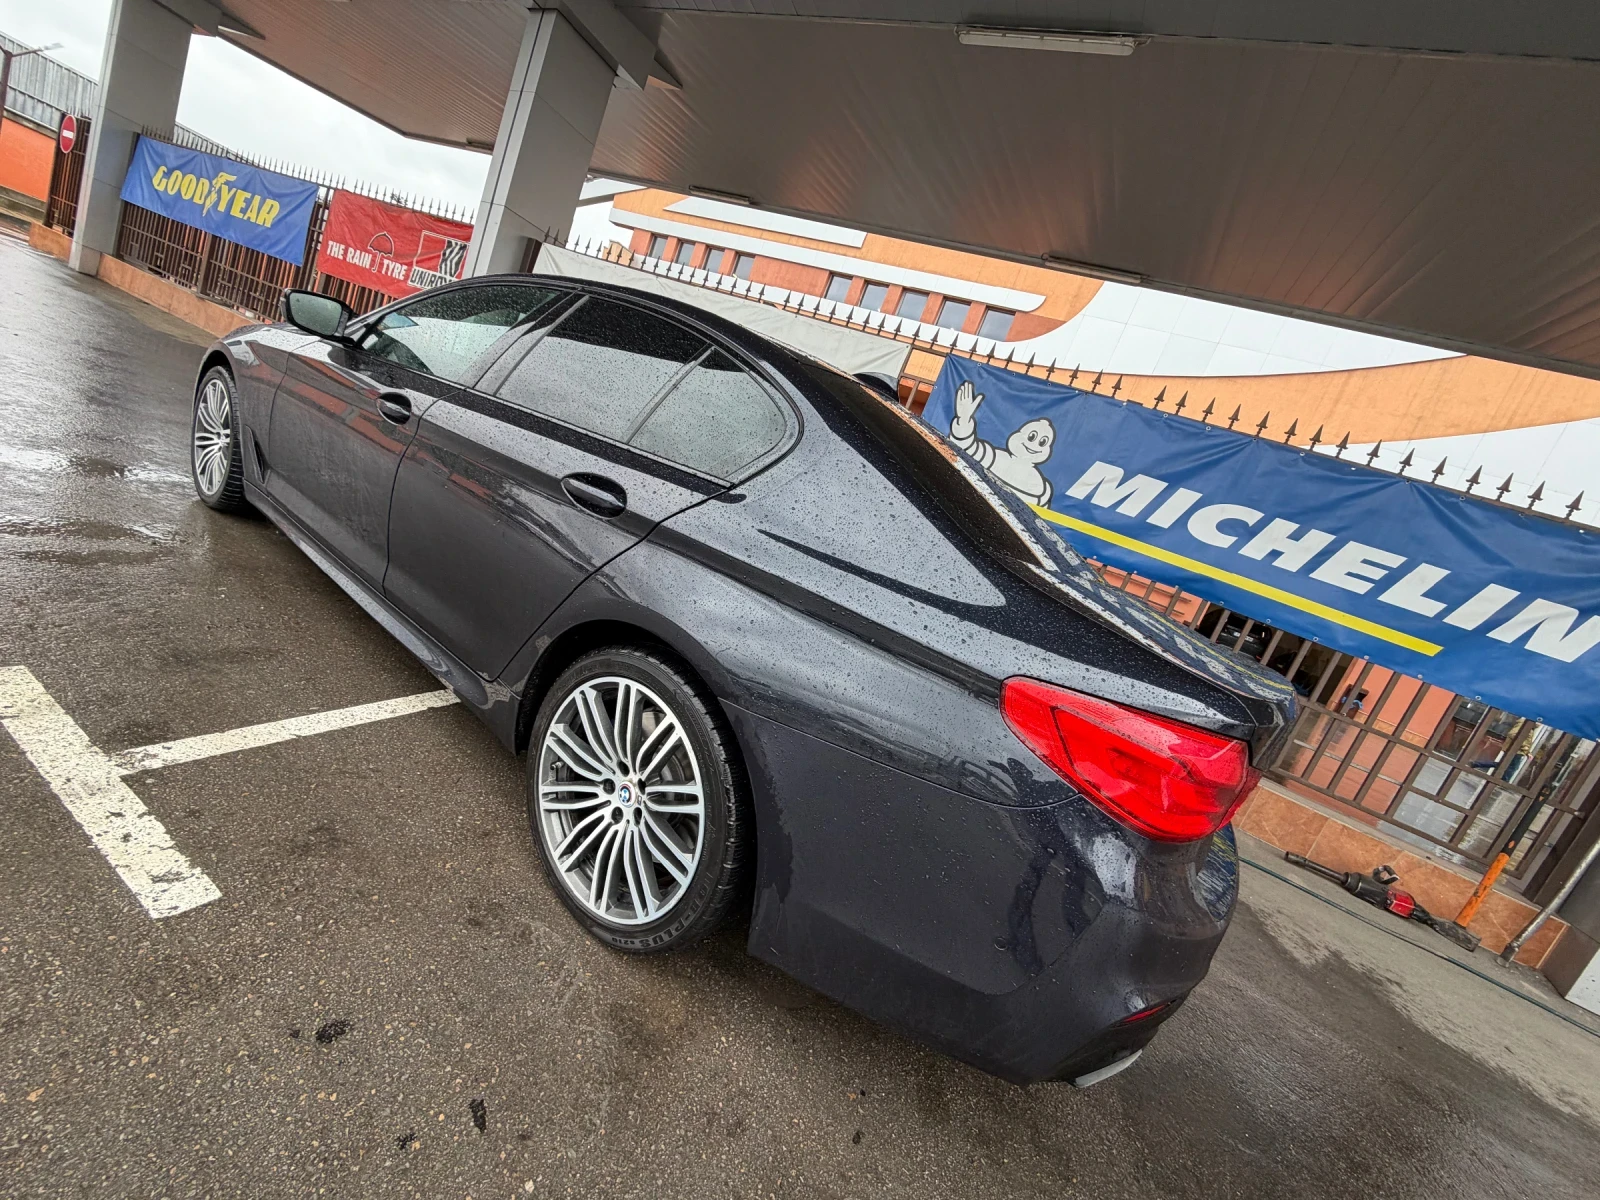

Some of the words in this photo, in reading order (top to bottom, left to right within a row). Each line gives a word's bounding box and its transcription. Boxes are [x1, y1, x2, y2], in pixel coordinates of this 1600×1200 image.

[152, 165, 280, 228] GOODYEAR
[326, 240, 345, 260] THE
[346, 247, 373, 269] RAIN
[381, 258, 408, 280] TYRE
[1065, 460, 1600, 663] MICHELIN
